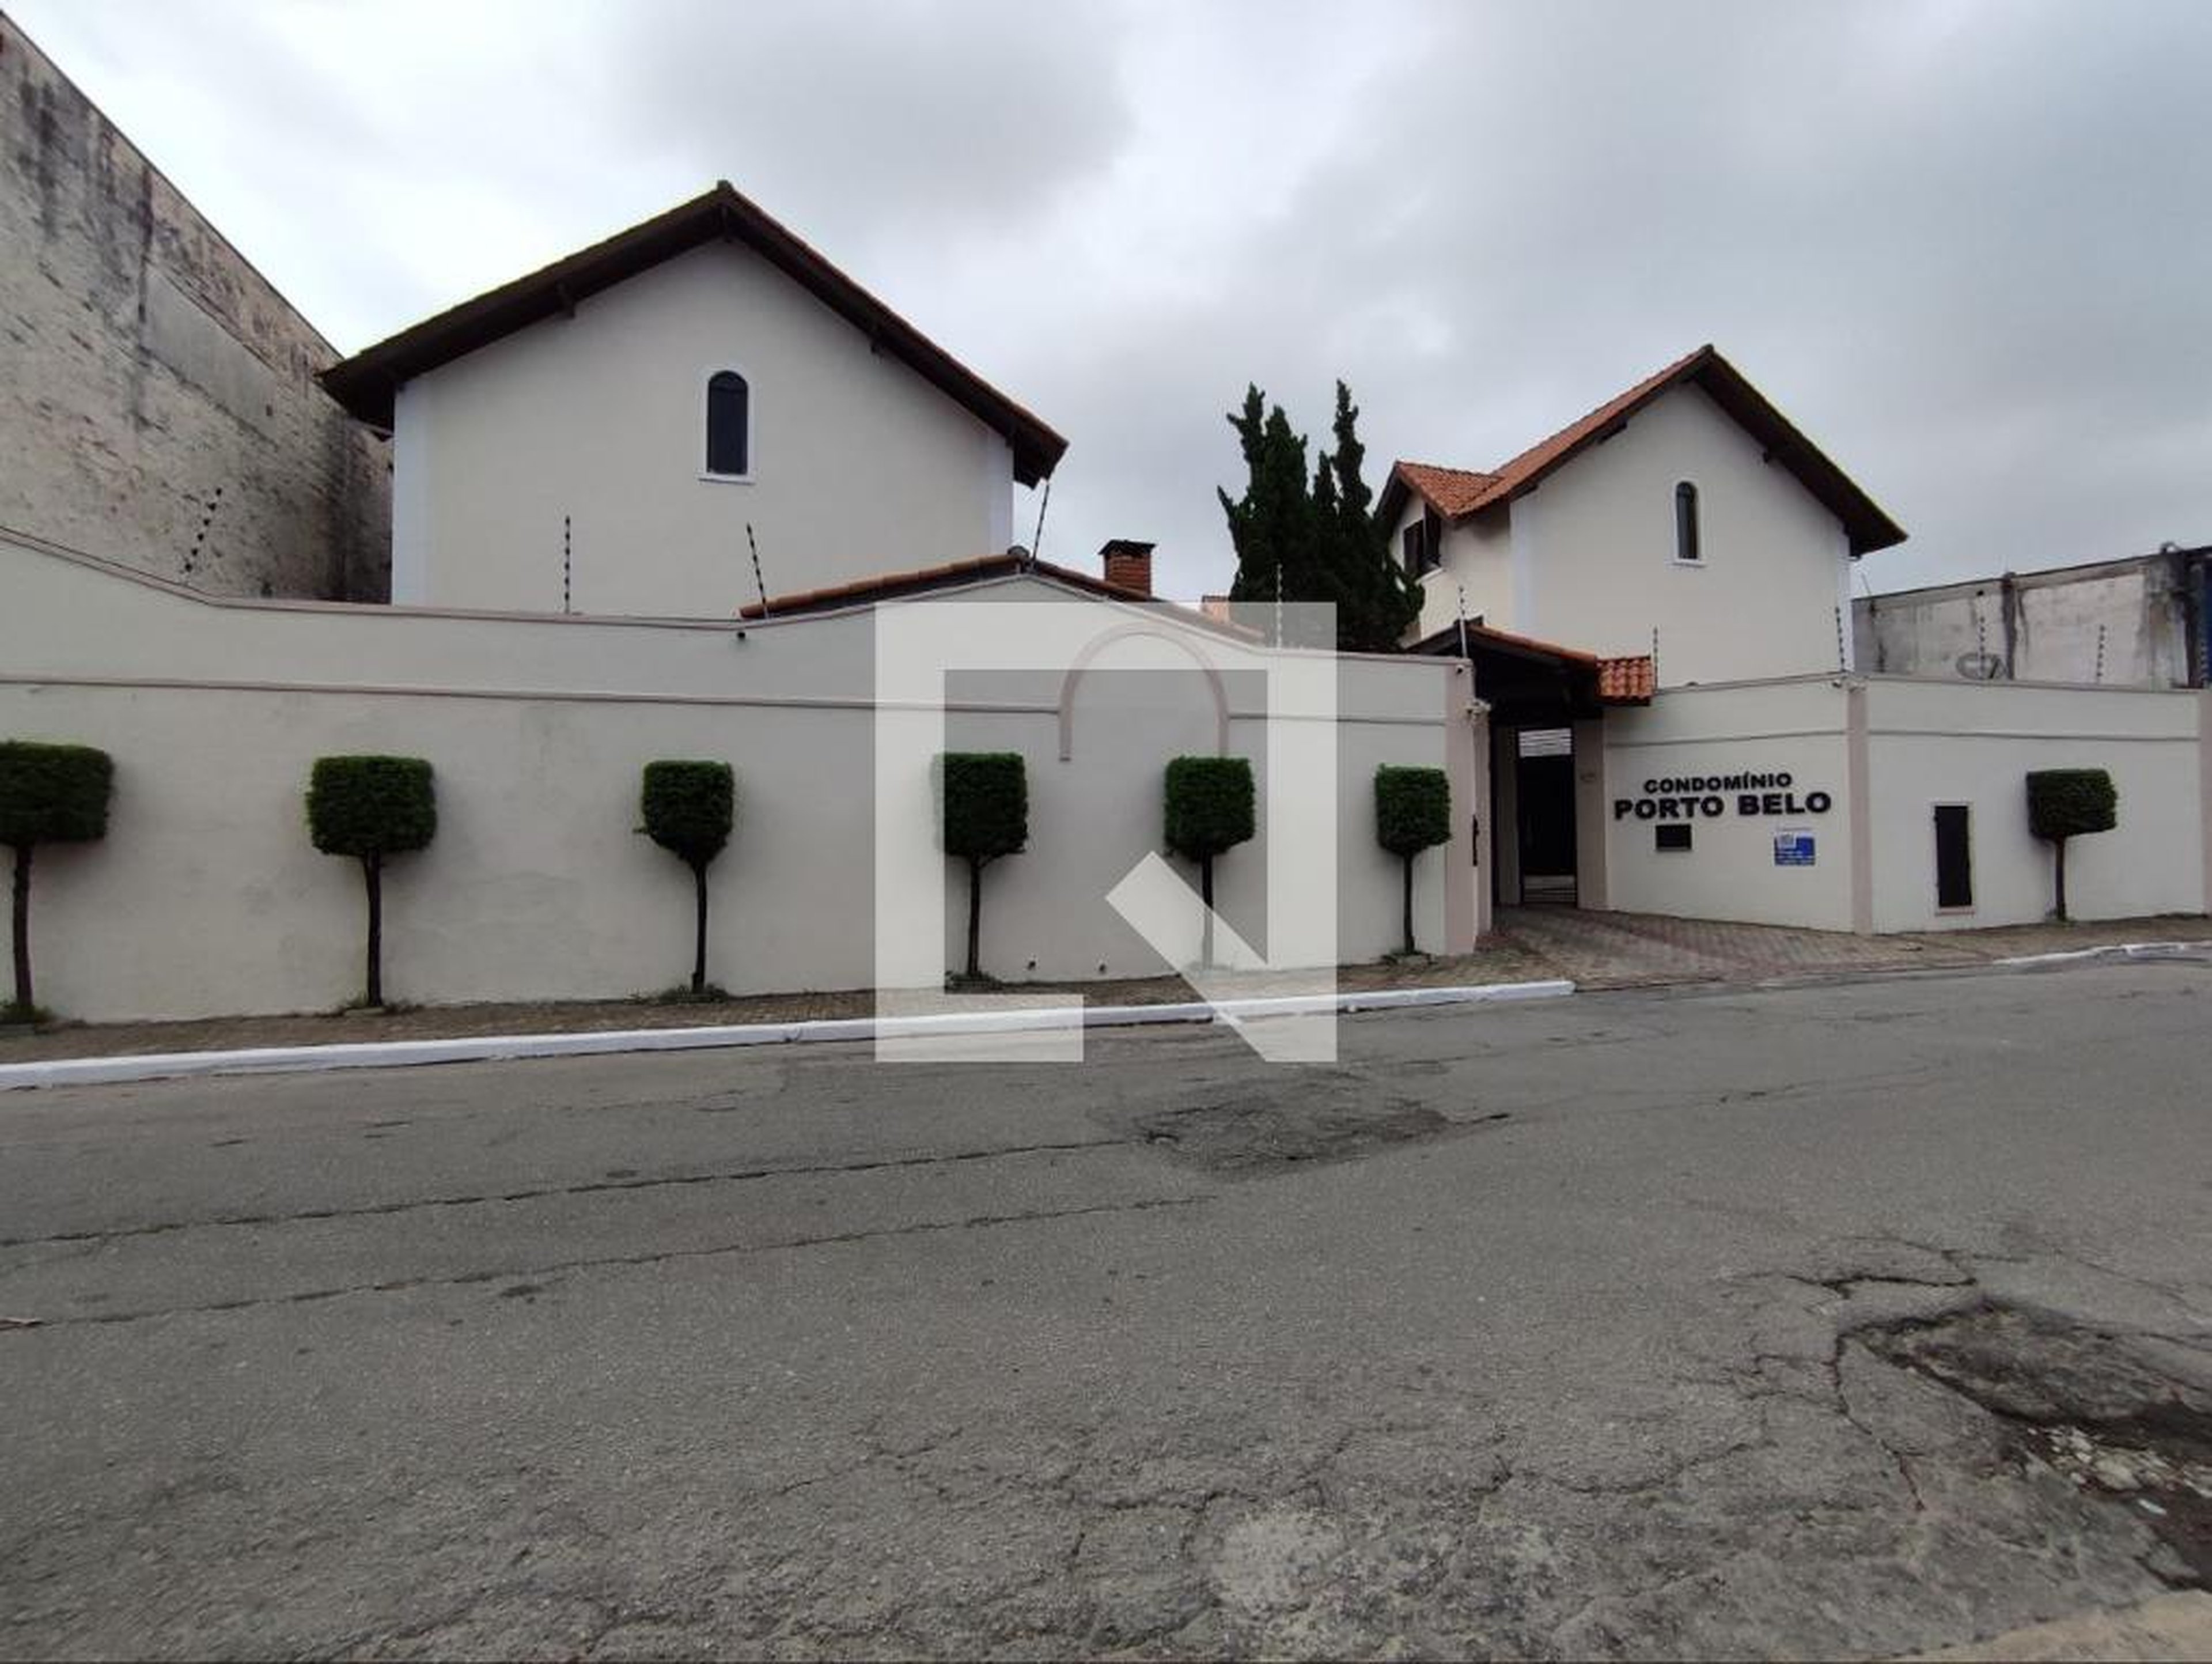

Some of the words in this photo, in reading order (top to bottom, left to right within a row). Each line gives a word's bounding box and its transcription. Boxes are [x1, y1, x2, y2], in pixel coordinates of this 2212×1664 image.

[1644, 772, 1792, 793] CONDOMÍNIO
[1615, 796, 1725, 820] PORTO
[1737, 792, 1832, 815] BELO
